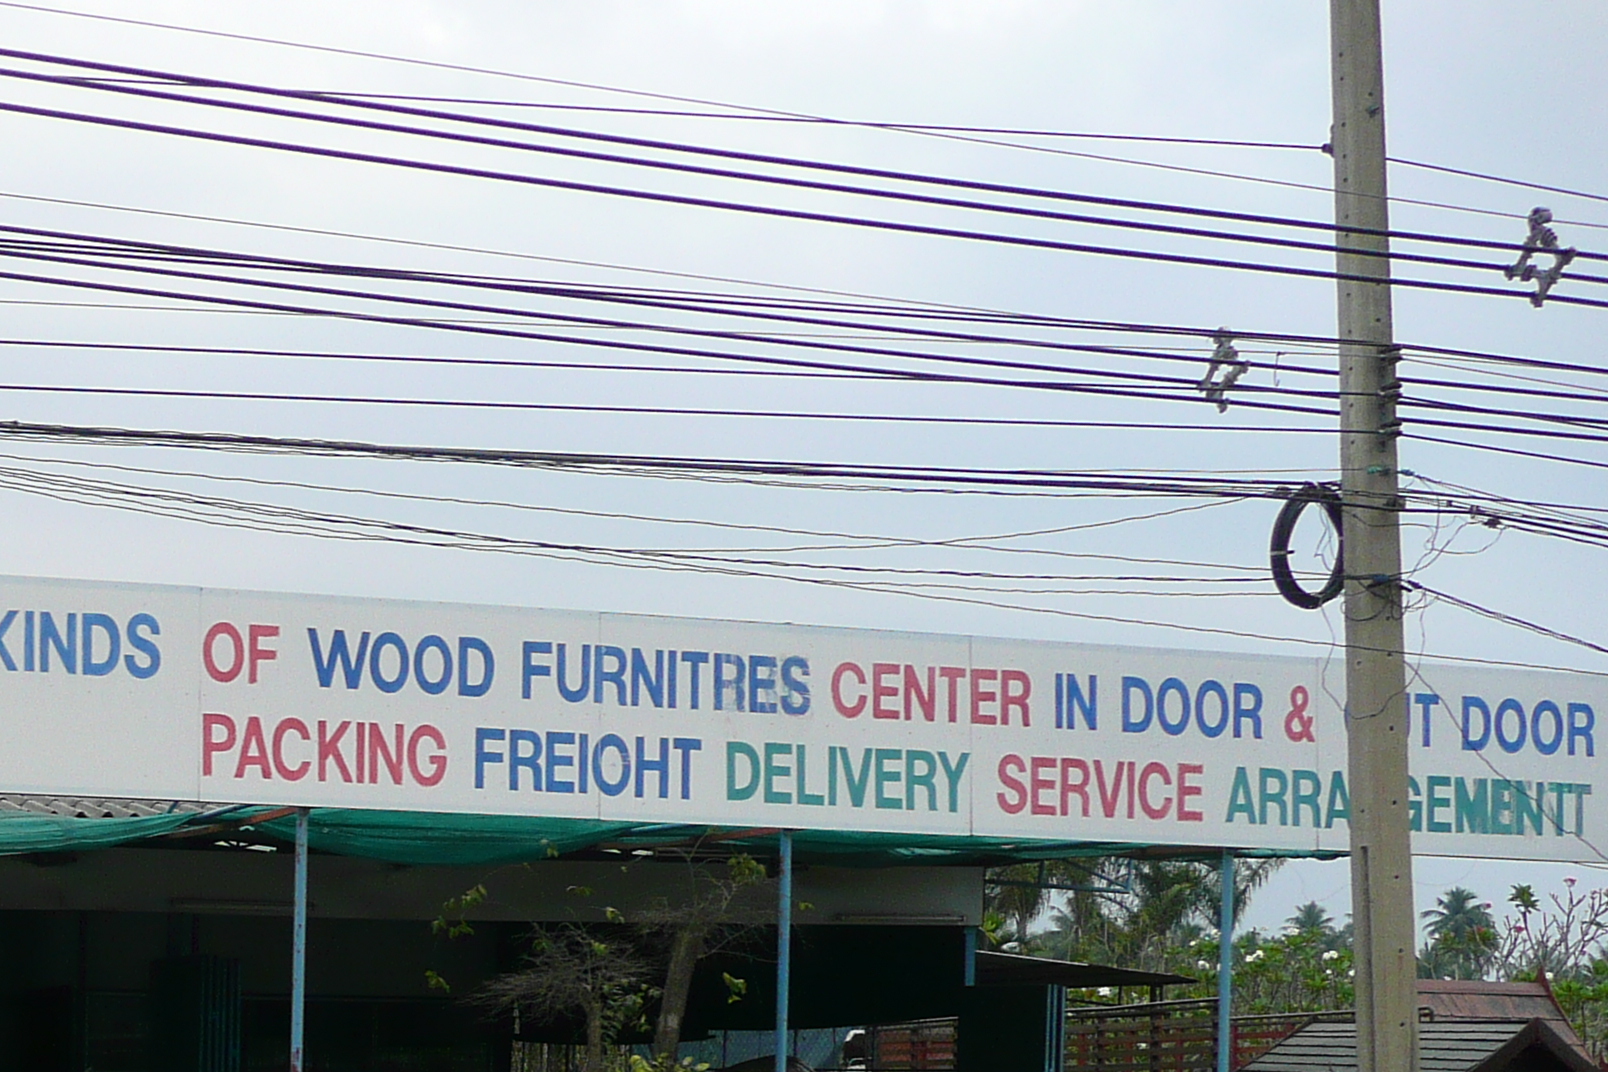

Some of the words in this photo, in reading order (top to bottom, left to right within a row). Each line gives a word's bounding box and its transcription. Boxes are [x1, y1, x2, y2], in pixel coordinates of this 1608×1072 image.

[203, 621, 280, 684] OF
[308, 628, 495, 698] WOOD
[522, 641, 811, 716] FURNITRES
[831, 662, 1032, 727] CENTER
[1055, 673, 1098, 731] IN
[1122, 676, 1263, 739] DOOR
[1284, 685, 1316, 742] &
[1461, 695, 1596, 757] DOOR
[202, 713, 448, 788] PACKING
[726, 741, 971, 812] DELIVERY
[997, 753, 1204, 821] SERVICE
